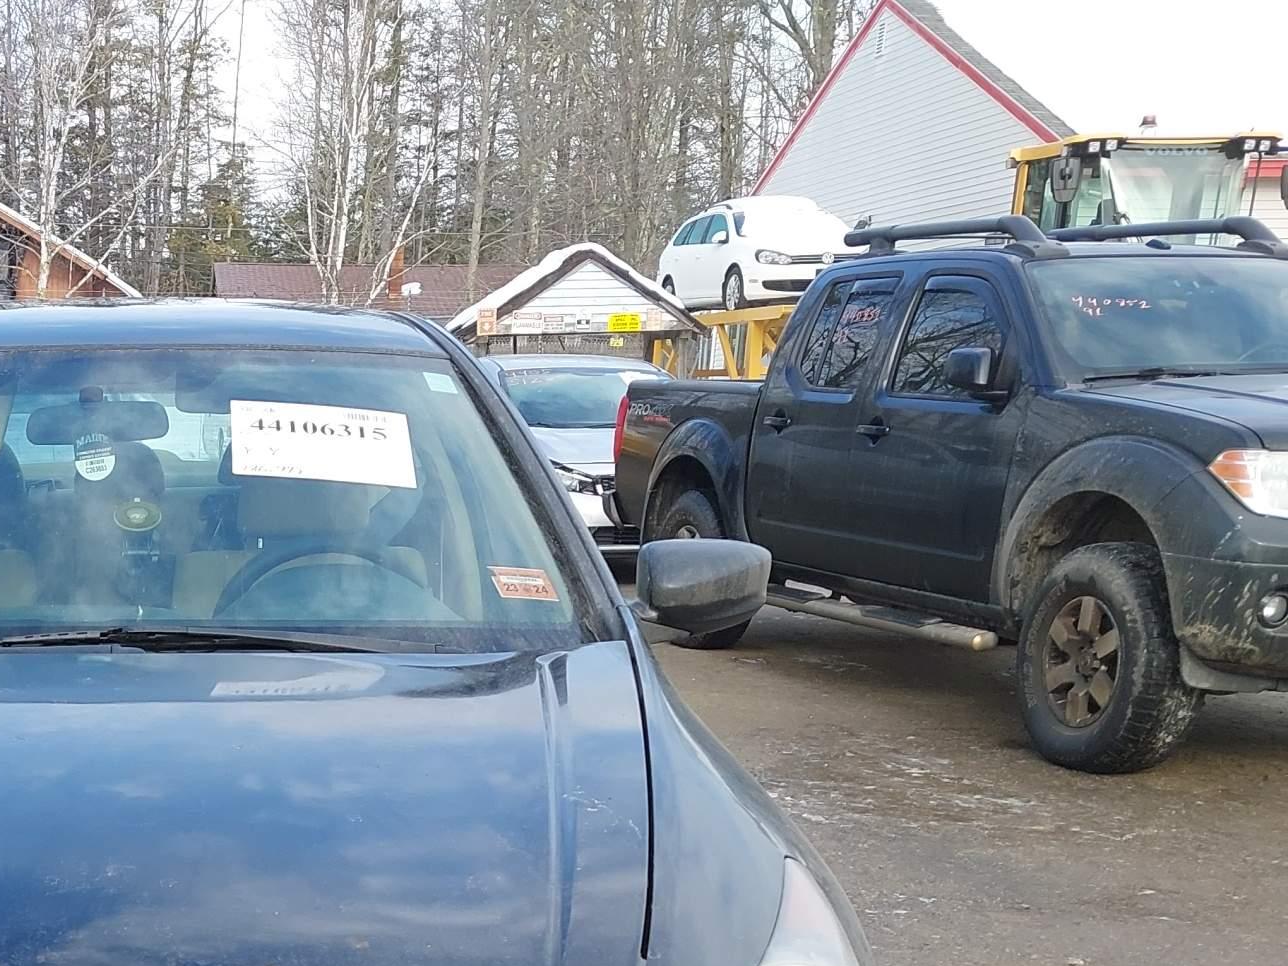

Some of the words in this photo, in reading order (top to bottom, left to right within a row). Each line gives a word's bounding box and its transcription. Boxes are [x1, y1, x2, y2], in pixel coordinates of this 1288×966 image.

[1143, 147, 1208, 156] VOLVO
[250, 418, 388, 440] 44106315
[503, 583, 519, 592] 23
[532, 585, 549, 594] 24
